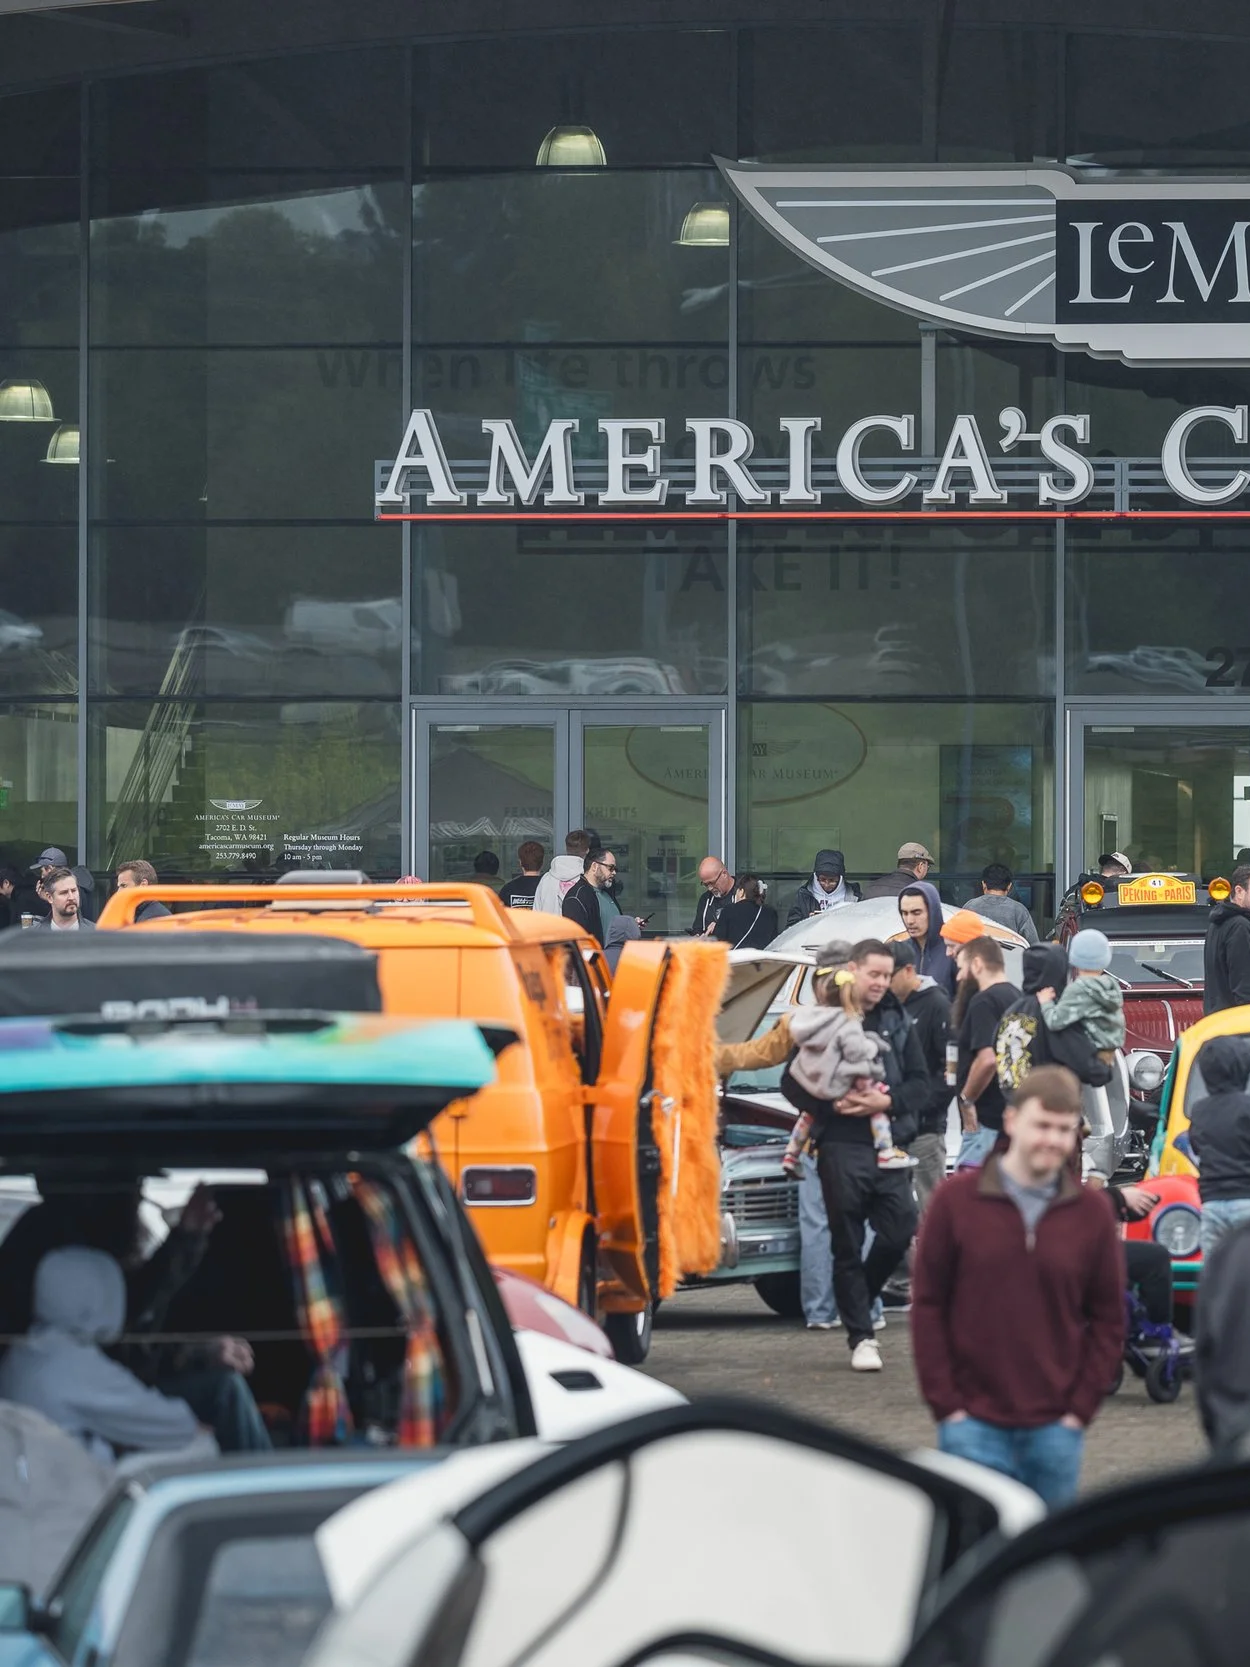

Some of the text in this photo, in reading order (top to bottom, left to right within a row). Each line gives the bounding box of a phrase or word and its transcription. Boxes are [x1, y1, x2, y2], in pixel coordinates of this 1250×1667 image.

[505, 347, 589, 388] lfe
[376, 406, 1094, 506] AMERICA'S
[585, 806, 637, 819] XHIBITS
[215, 824, 231, 832] 2702
[205, 833, 233, 842] Tacoma,
[283, 834, 309, 842] Regular
[198, 842, 275, 851] americascarmuseum.org
[283, 844, 363, 852] Thursday through Monday
[215, 852, 257, 860] 253.779.8490
[1123, 886, 1191, 901] PEKING PARIS
